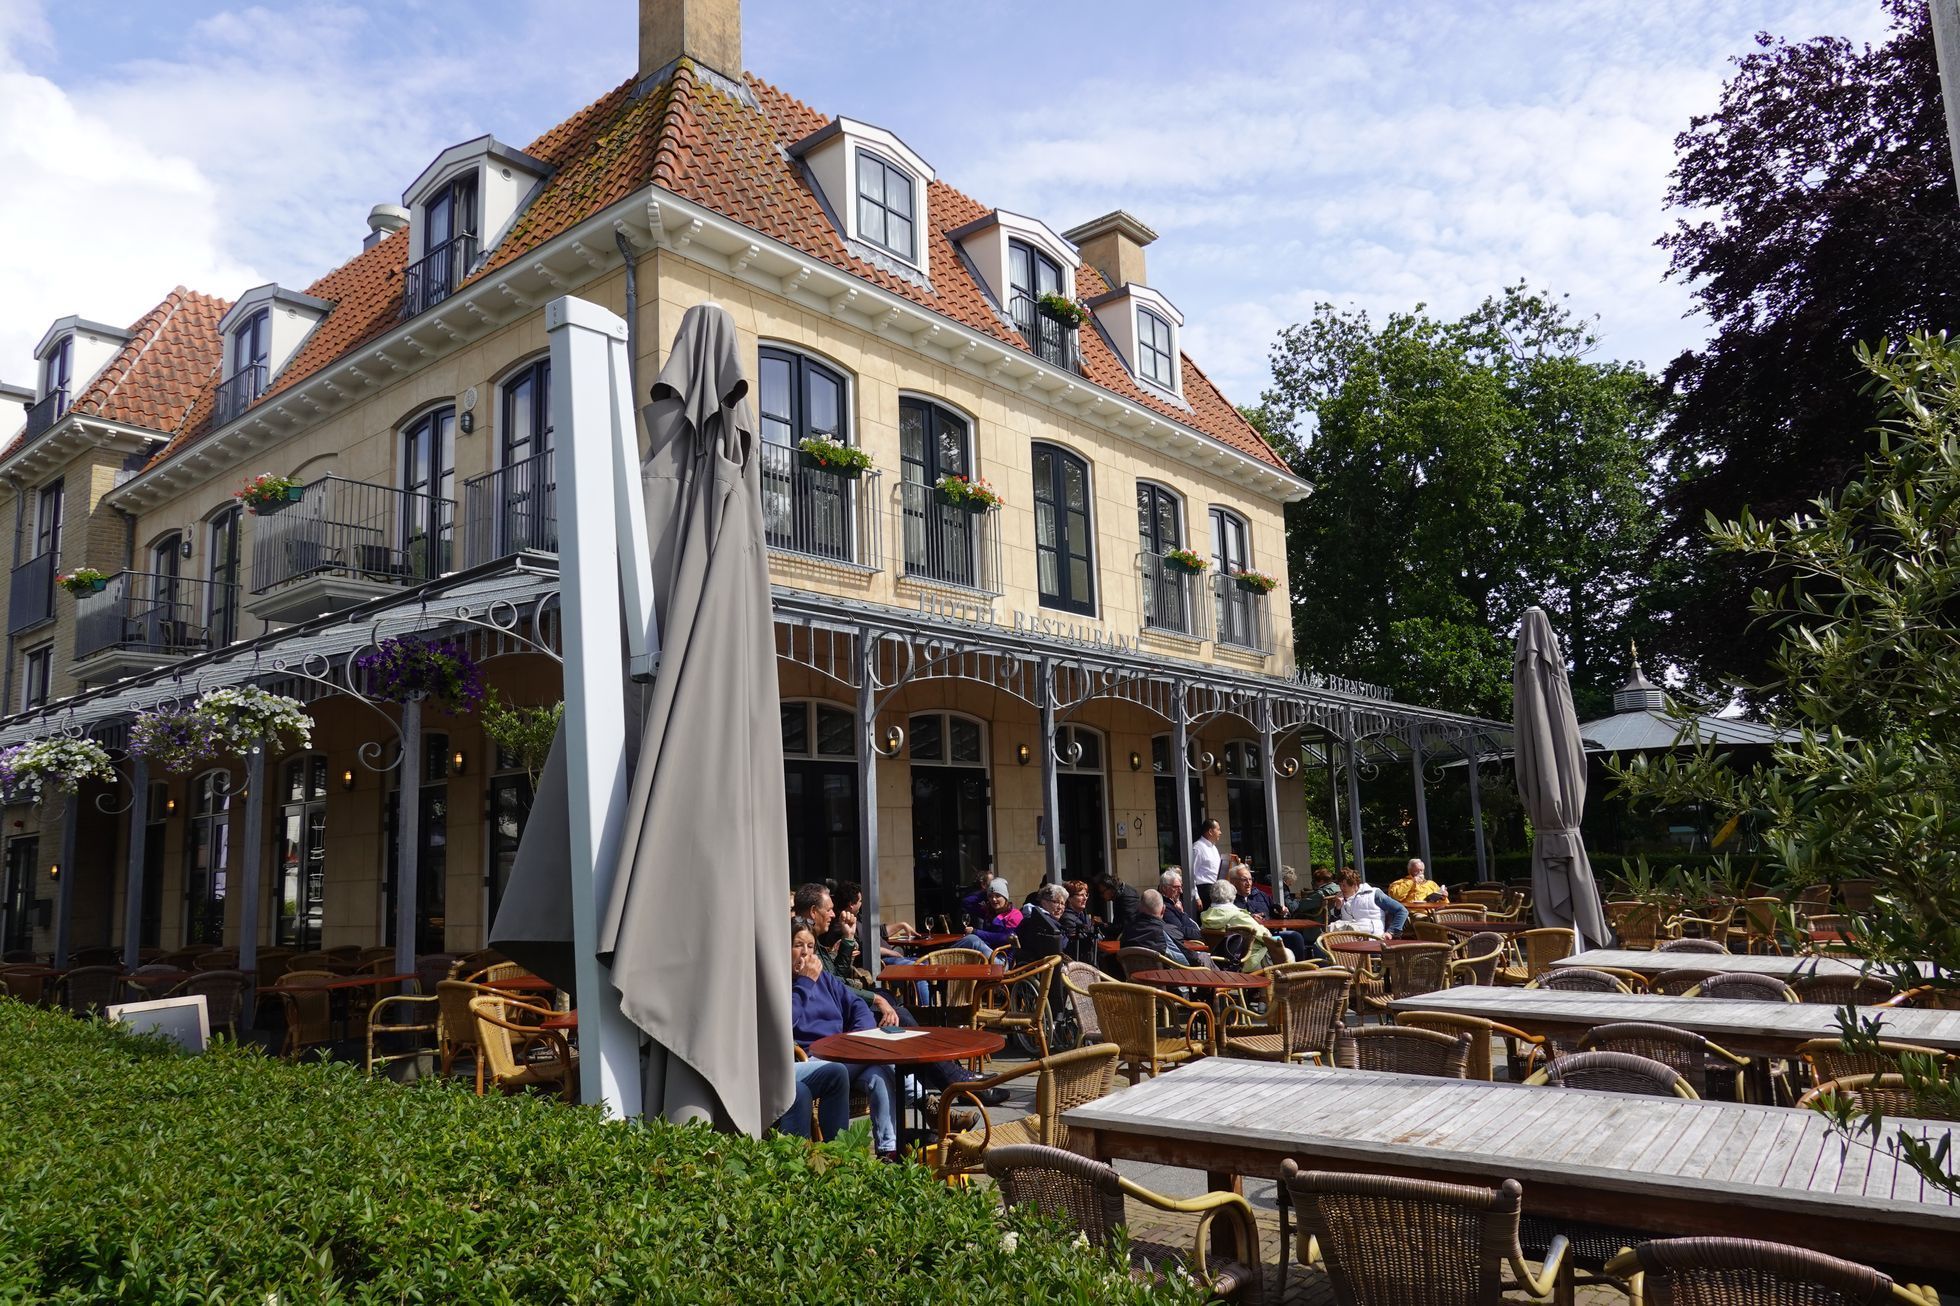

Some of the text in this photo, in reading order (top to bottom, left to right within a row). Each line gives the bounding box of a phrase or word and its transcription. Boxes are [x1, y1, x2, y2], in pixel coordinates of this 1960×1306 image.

[918, 591, 1394, 701] HOTEL RESTAURANT GRAAF BERNSTORFF
